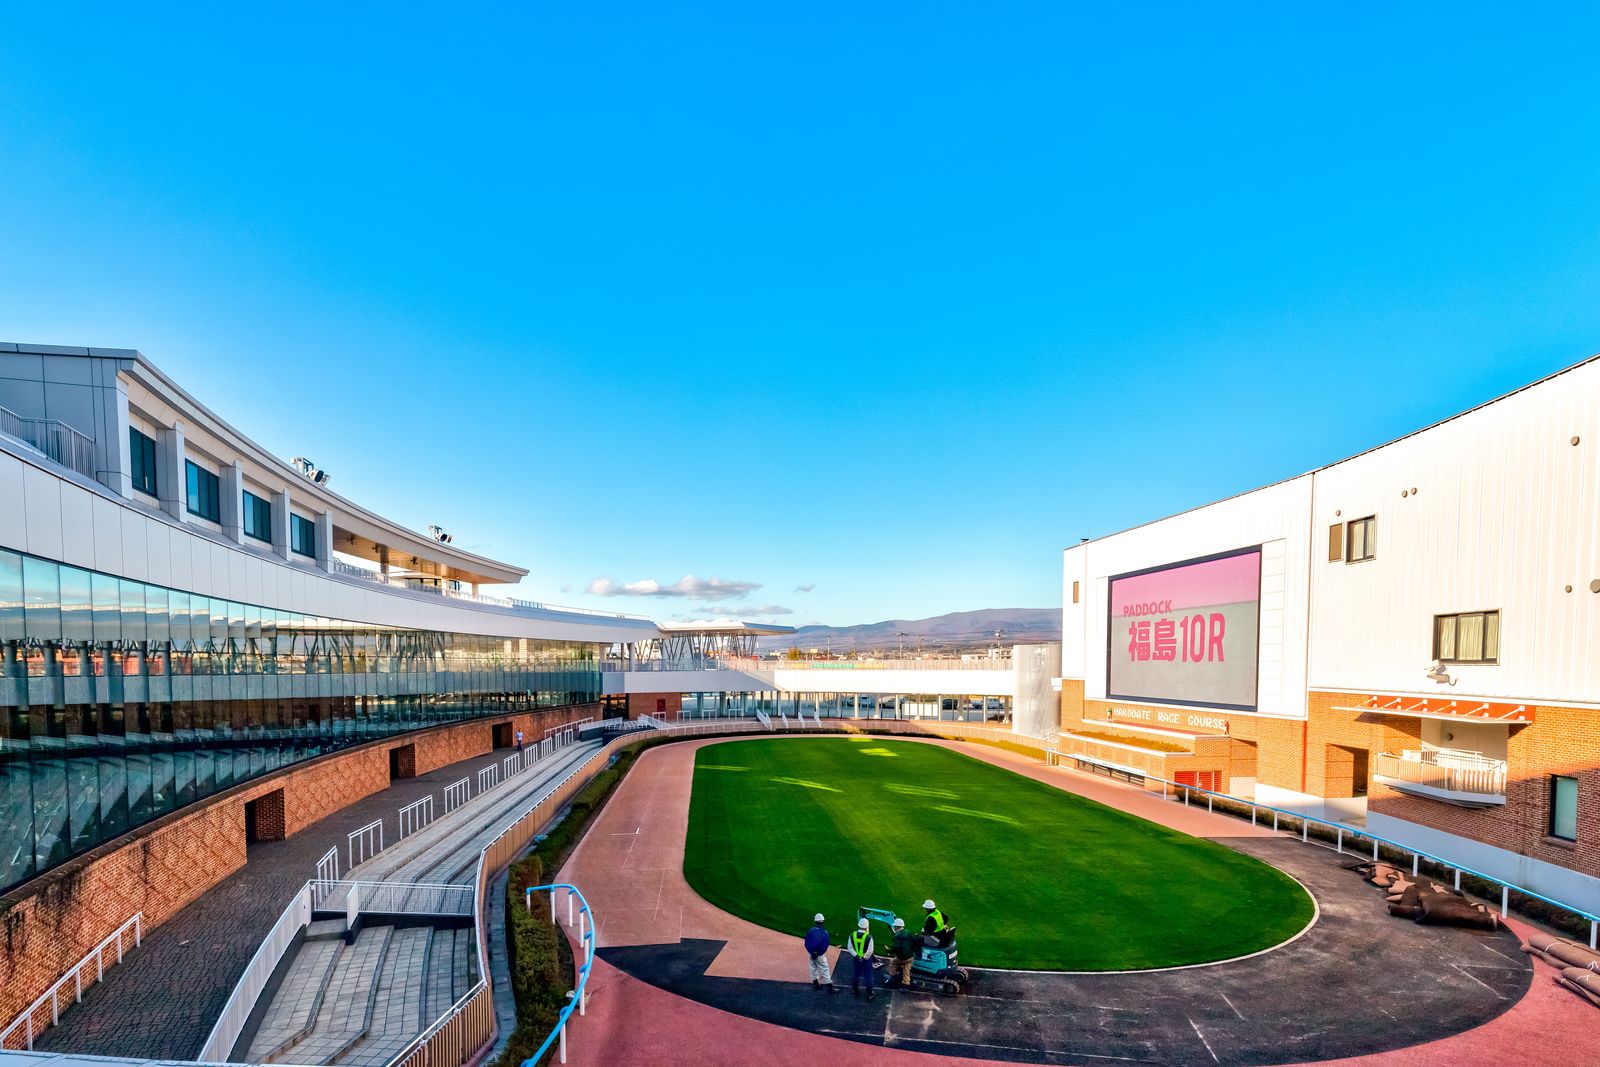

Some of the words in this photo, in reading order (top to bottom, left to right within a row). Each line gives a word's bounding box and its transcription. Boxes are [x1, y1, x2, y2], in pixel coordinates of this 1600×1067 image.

[1123, 600, 1172, 617] PADDOCK
[1113, 708, 1151, 720] HAKODATE
[1157, 711, 1180, 724] RACE
[1187, 715, 1226, 729] COURSE
